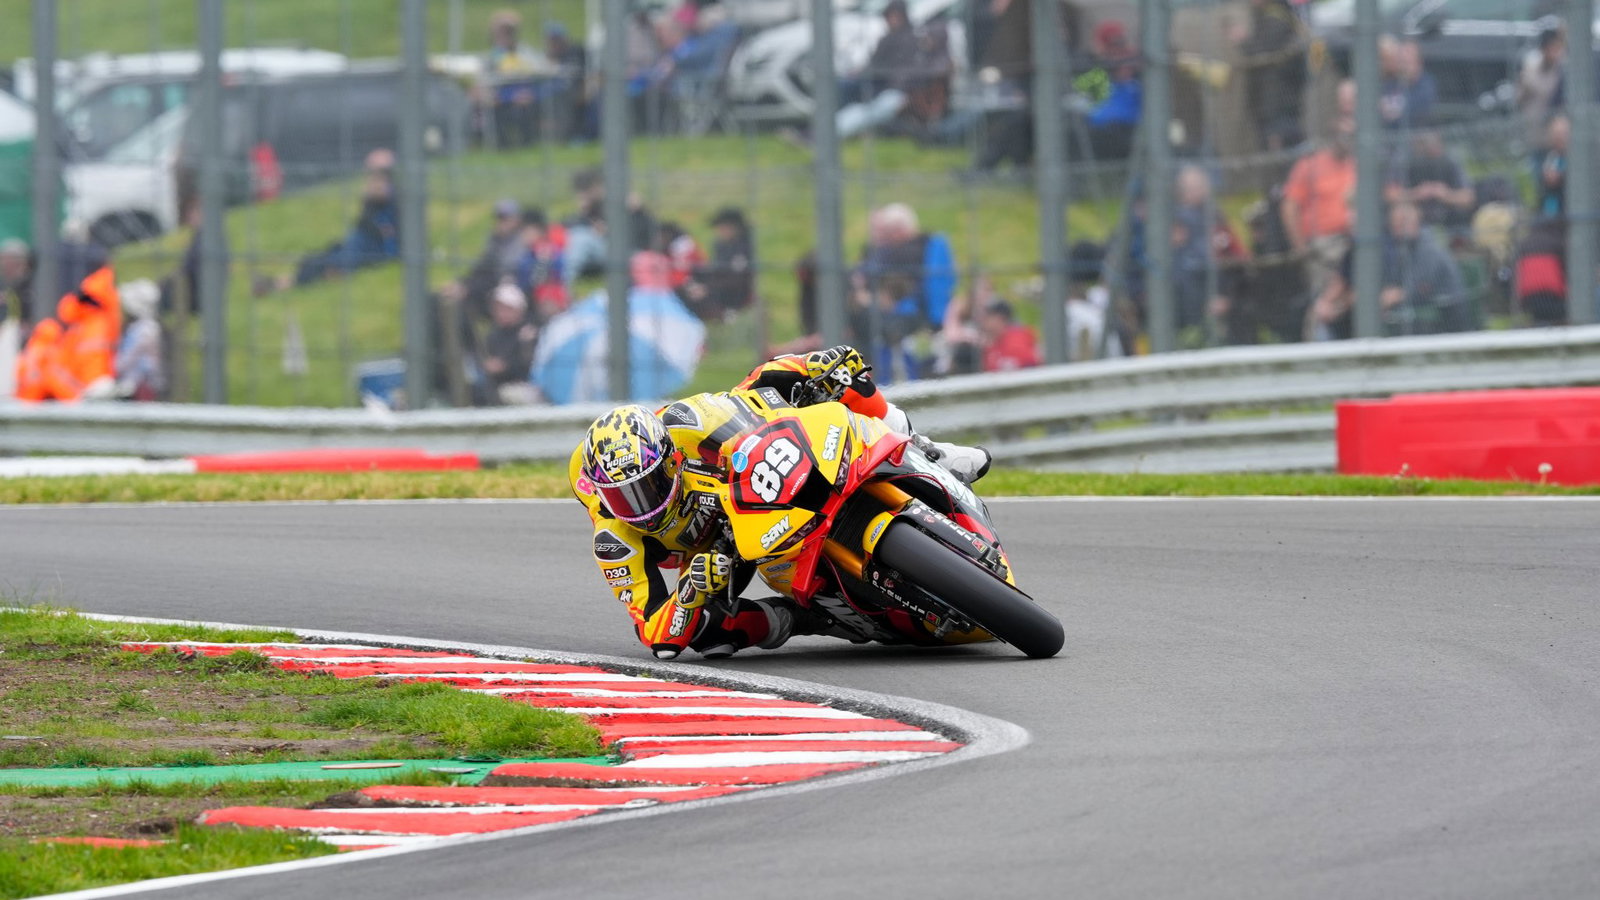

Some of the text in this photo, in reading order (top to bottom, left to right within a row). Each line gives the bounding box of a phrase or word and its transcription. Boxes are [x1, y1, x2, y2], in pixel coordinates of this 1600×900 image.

[607, 453, 635, 469] NOLAN
[750, 437, 801, 504] 89
[790, 473, 807, 496] HONDA
